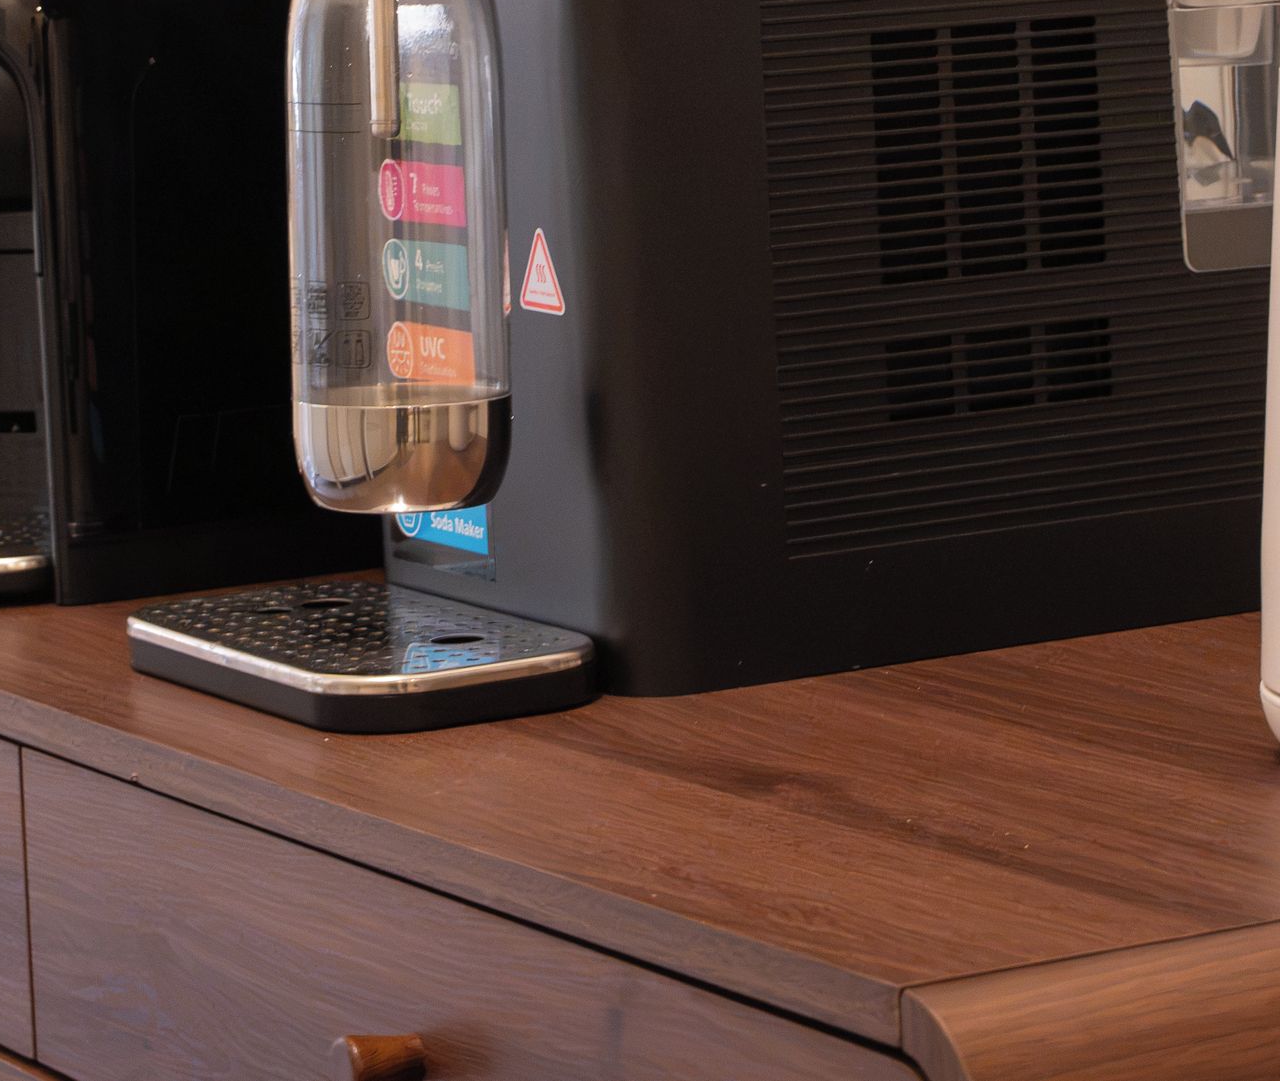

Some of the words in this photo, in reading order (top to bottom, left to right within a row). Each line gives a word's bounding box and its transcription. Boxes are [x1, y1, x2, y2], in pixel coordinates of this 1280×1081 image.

[406, 92, 442, 115] Touch
[409, 172, 418, 194] 7
[414, 248, 424, 271] 4
[420, 336, 446, 360] UVC
[430, 512, 453, 532] Soda
[454, 517, 485, 539] Maker
